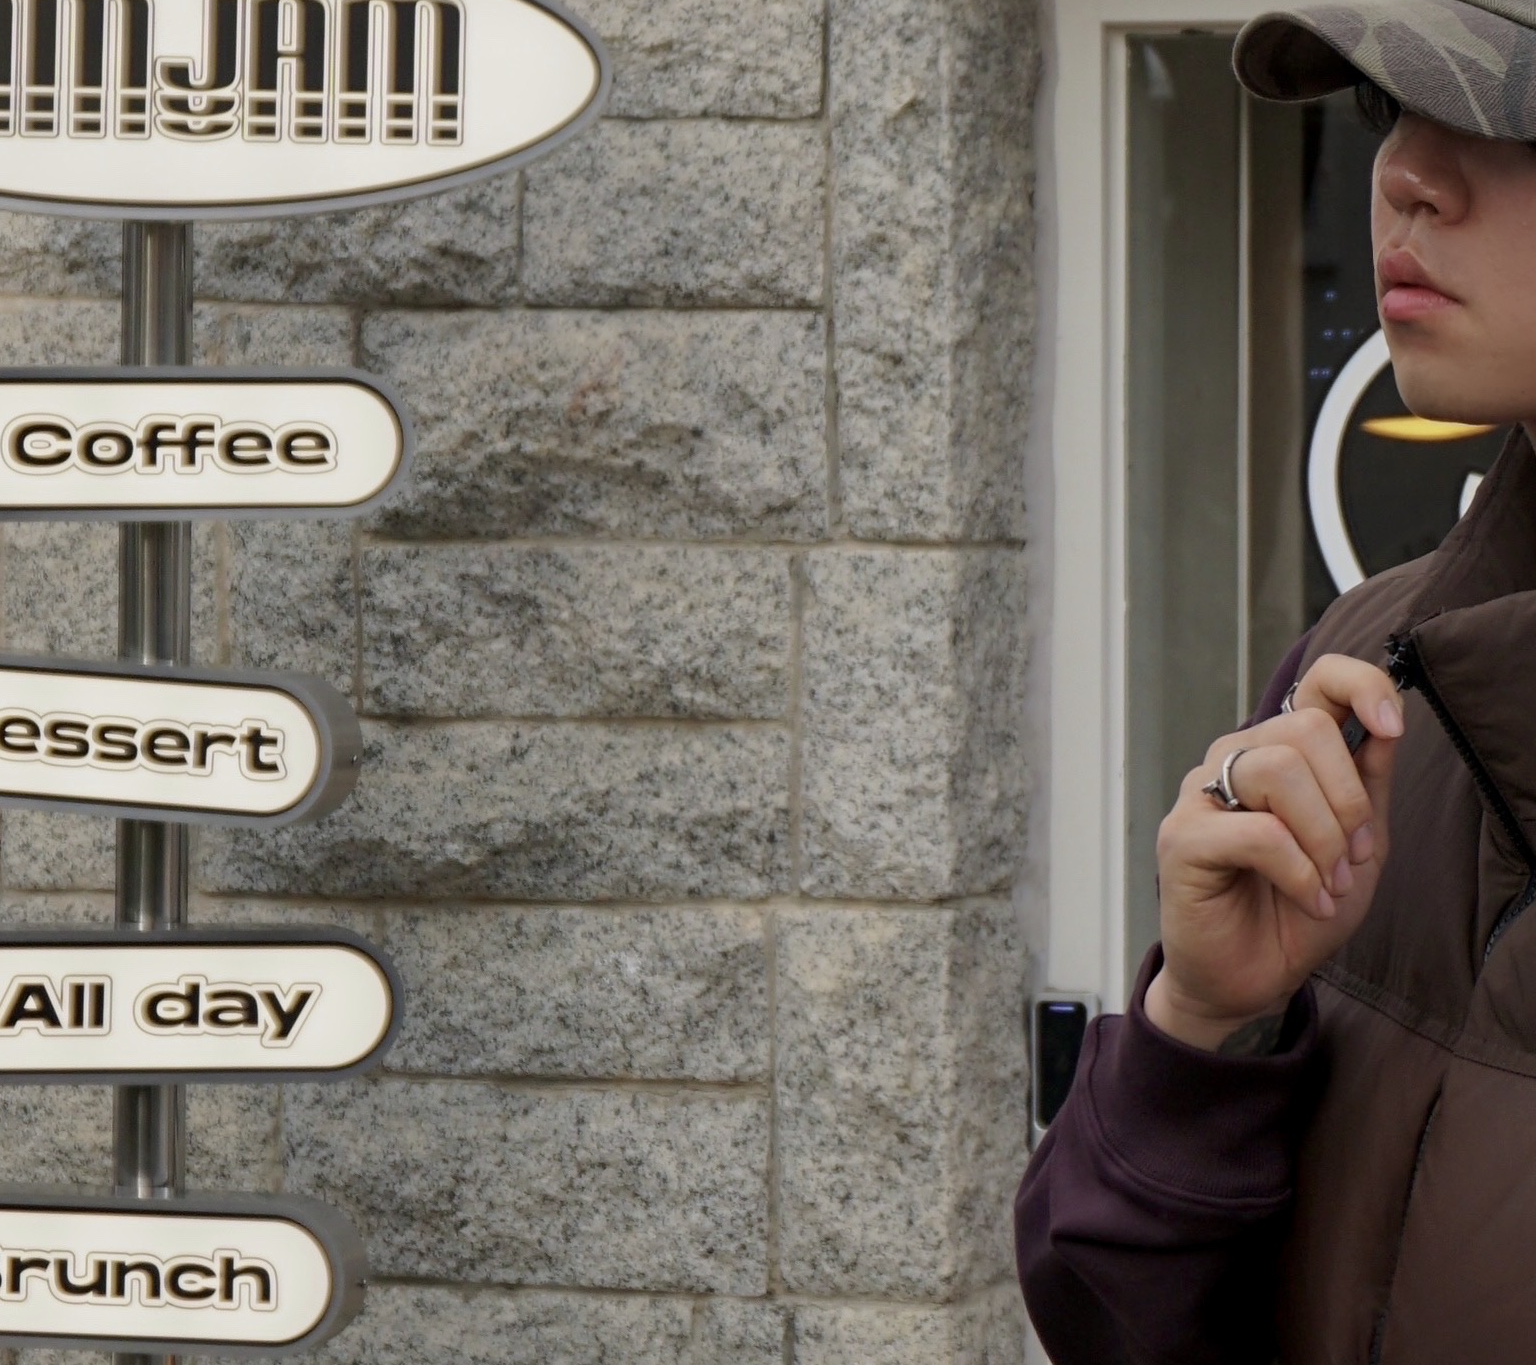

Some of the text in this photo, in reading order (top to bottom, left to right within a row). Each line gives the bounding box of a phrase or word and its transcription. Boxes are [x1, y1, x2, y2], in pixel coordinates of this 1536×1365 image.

[9, 421, 332, 469] Coffee
[0, 715, 281, 774] essert
[1, 982, 314, 1041] All day
[0, 1255, 273, 1305] runch
